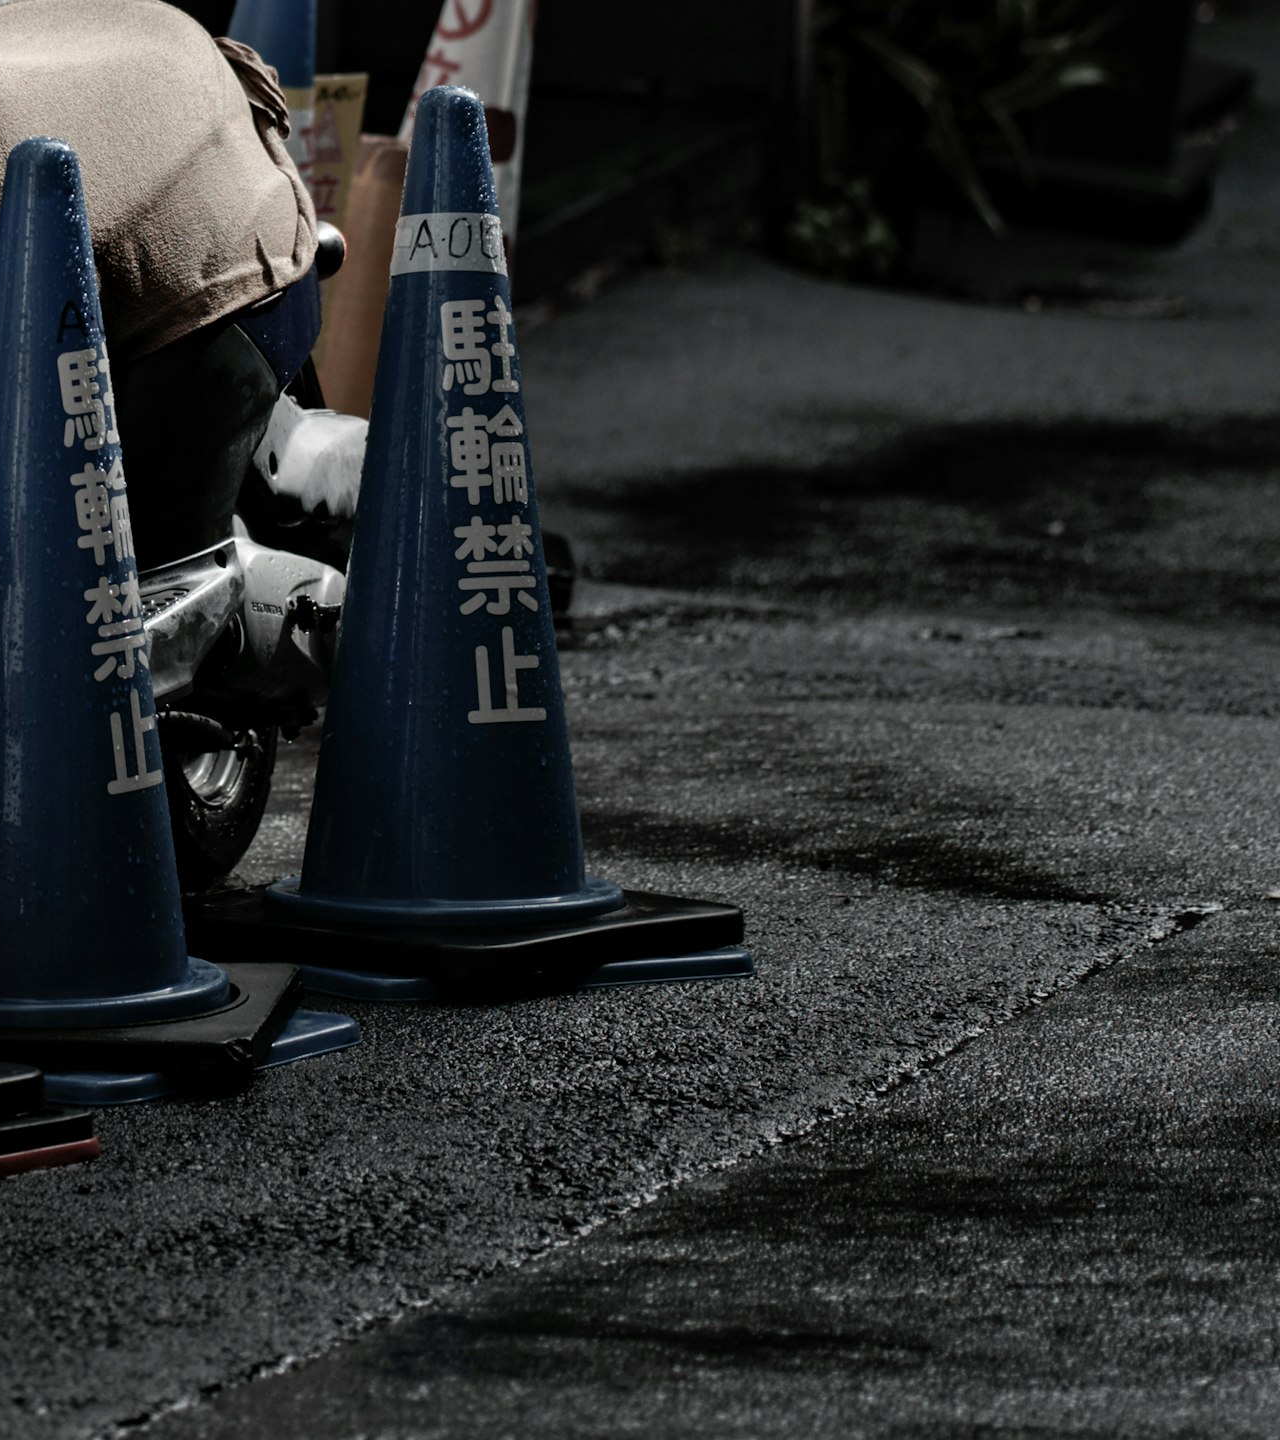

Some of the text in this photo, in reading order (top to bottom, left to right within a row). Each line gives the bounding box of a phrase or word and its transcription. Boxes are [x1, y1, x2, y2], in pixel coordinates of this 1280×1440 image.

[56, 341, 163, 797] 駐輪禁止
[250, 601, 285, 617] HONDA
[440, 293, 548, 727] 駐輪禁止
